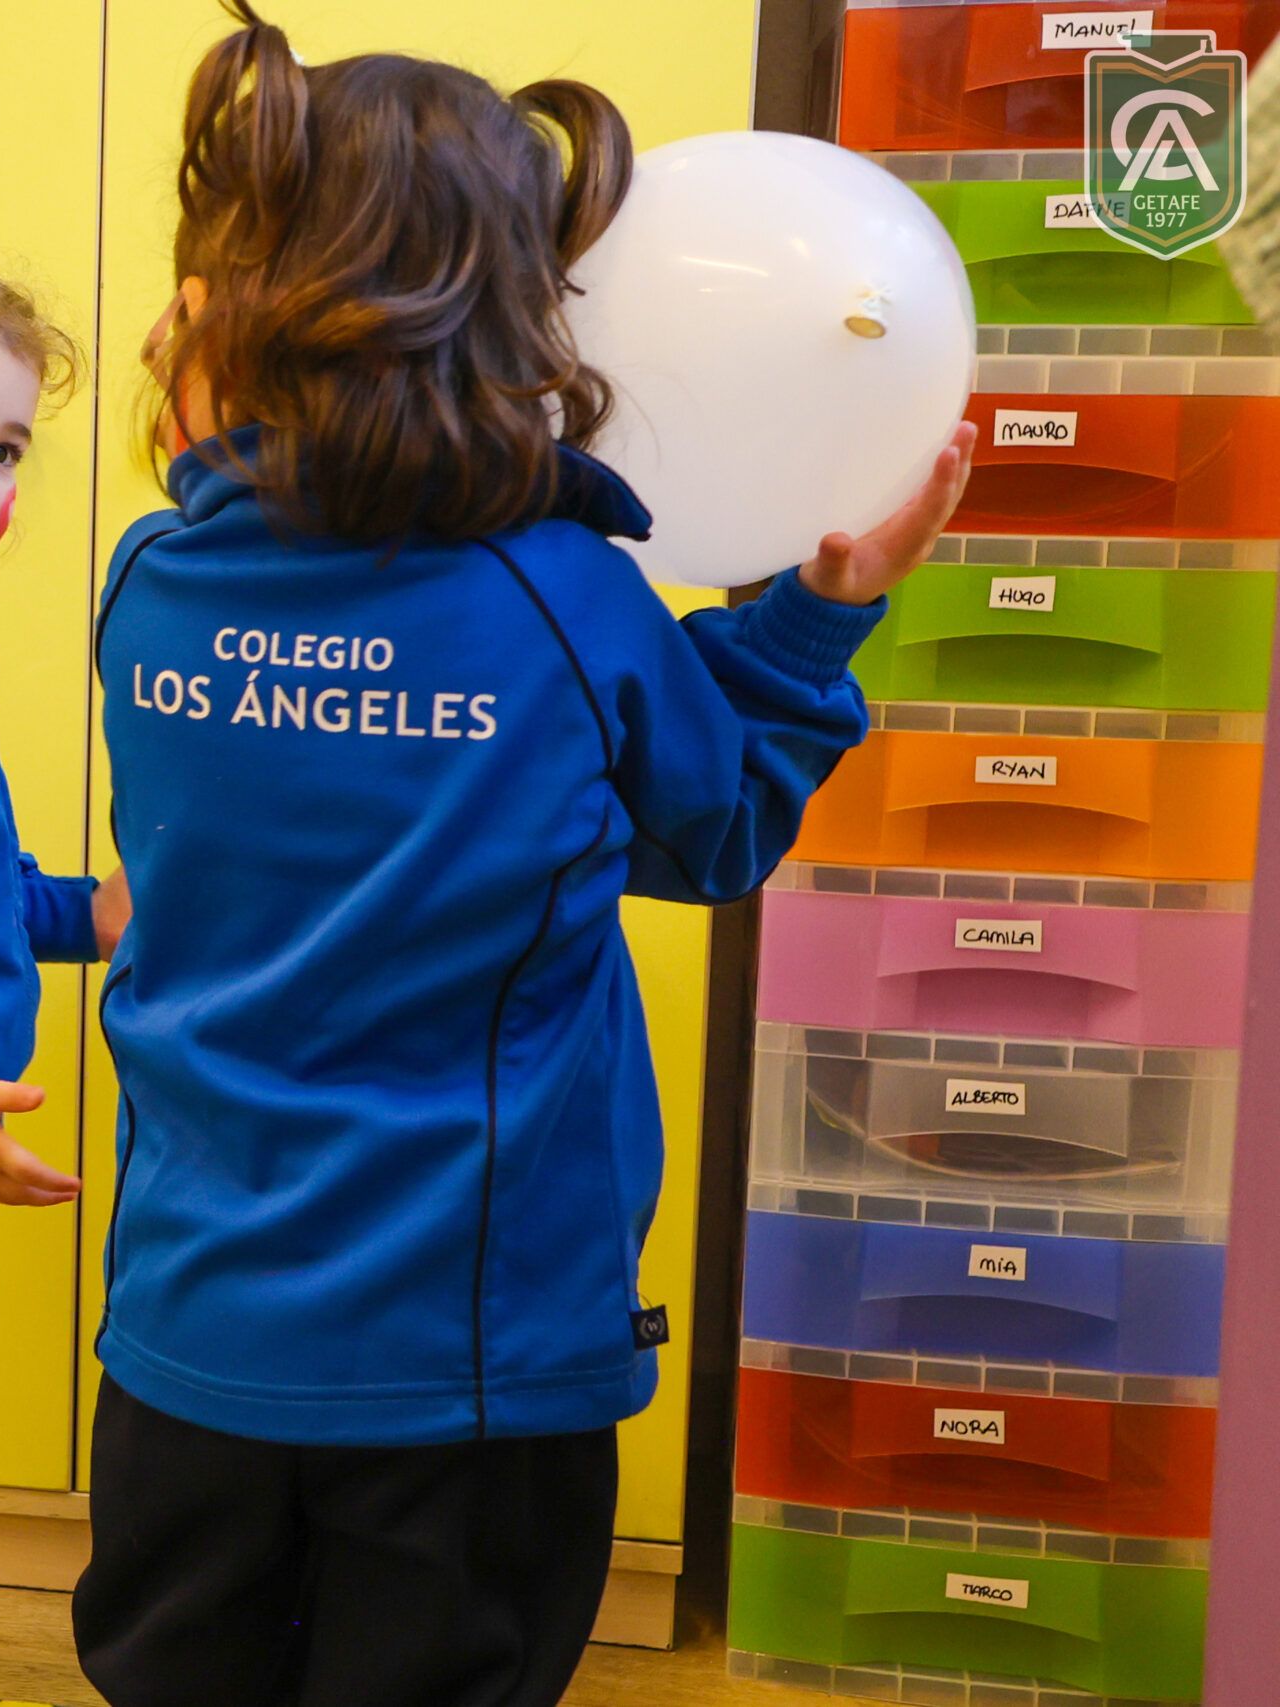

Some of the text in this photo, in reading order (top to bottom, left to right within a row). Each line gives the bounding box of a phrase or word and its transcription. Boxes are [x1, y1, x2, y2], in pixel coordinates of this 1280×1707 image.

[1002, 421, 1068, 440] MAURO
[213, 627, 395, 671] COLEGIO
[133, 663, 497, 741] LOS ÁNGELES
[992, 760, 1045, 779] RYAN
[963, 928, 1034, 946] CAMILA
[951, 1089, 1019, 1106] ALBERTO
[940, 1419, 999, 1437] NORA
